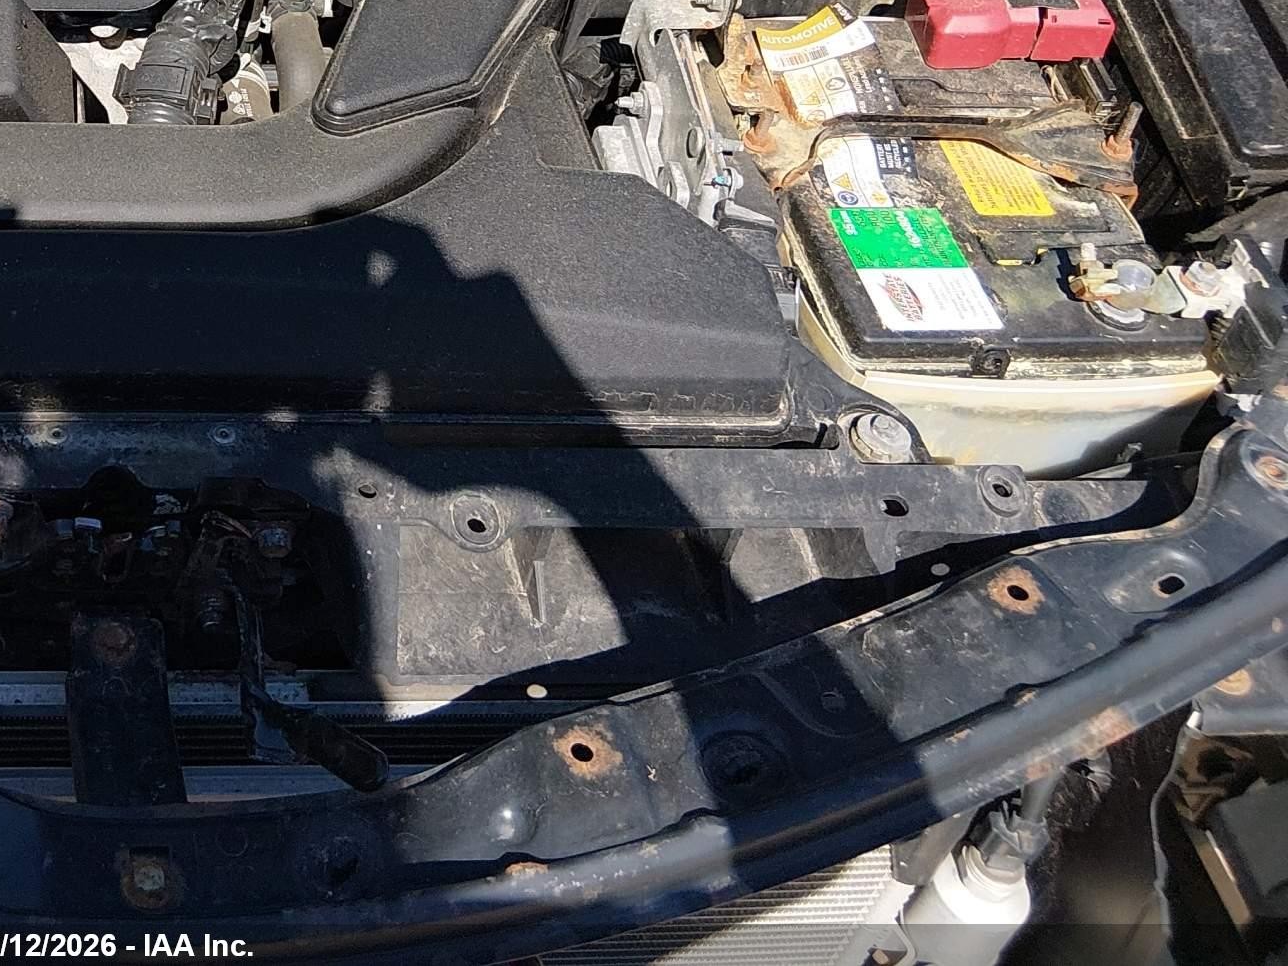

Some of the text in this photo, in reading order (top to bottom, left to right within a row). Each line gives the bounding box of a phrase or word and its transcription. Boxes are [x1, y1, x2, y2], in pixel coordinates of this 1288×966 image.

[759, 15, 837, 45] AUTOMOTIVE
[876, 143, 886, 168] BATTERY
[885, 152, 895, 168] MUST
[890, 139, 902, 168] RECYCLED
[881, 273, 914, 322] INTERSTATE
[893, 277, 924, 322] BATTERIES
